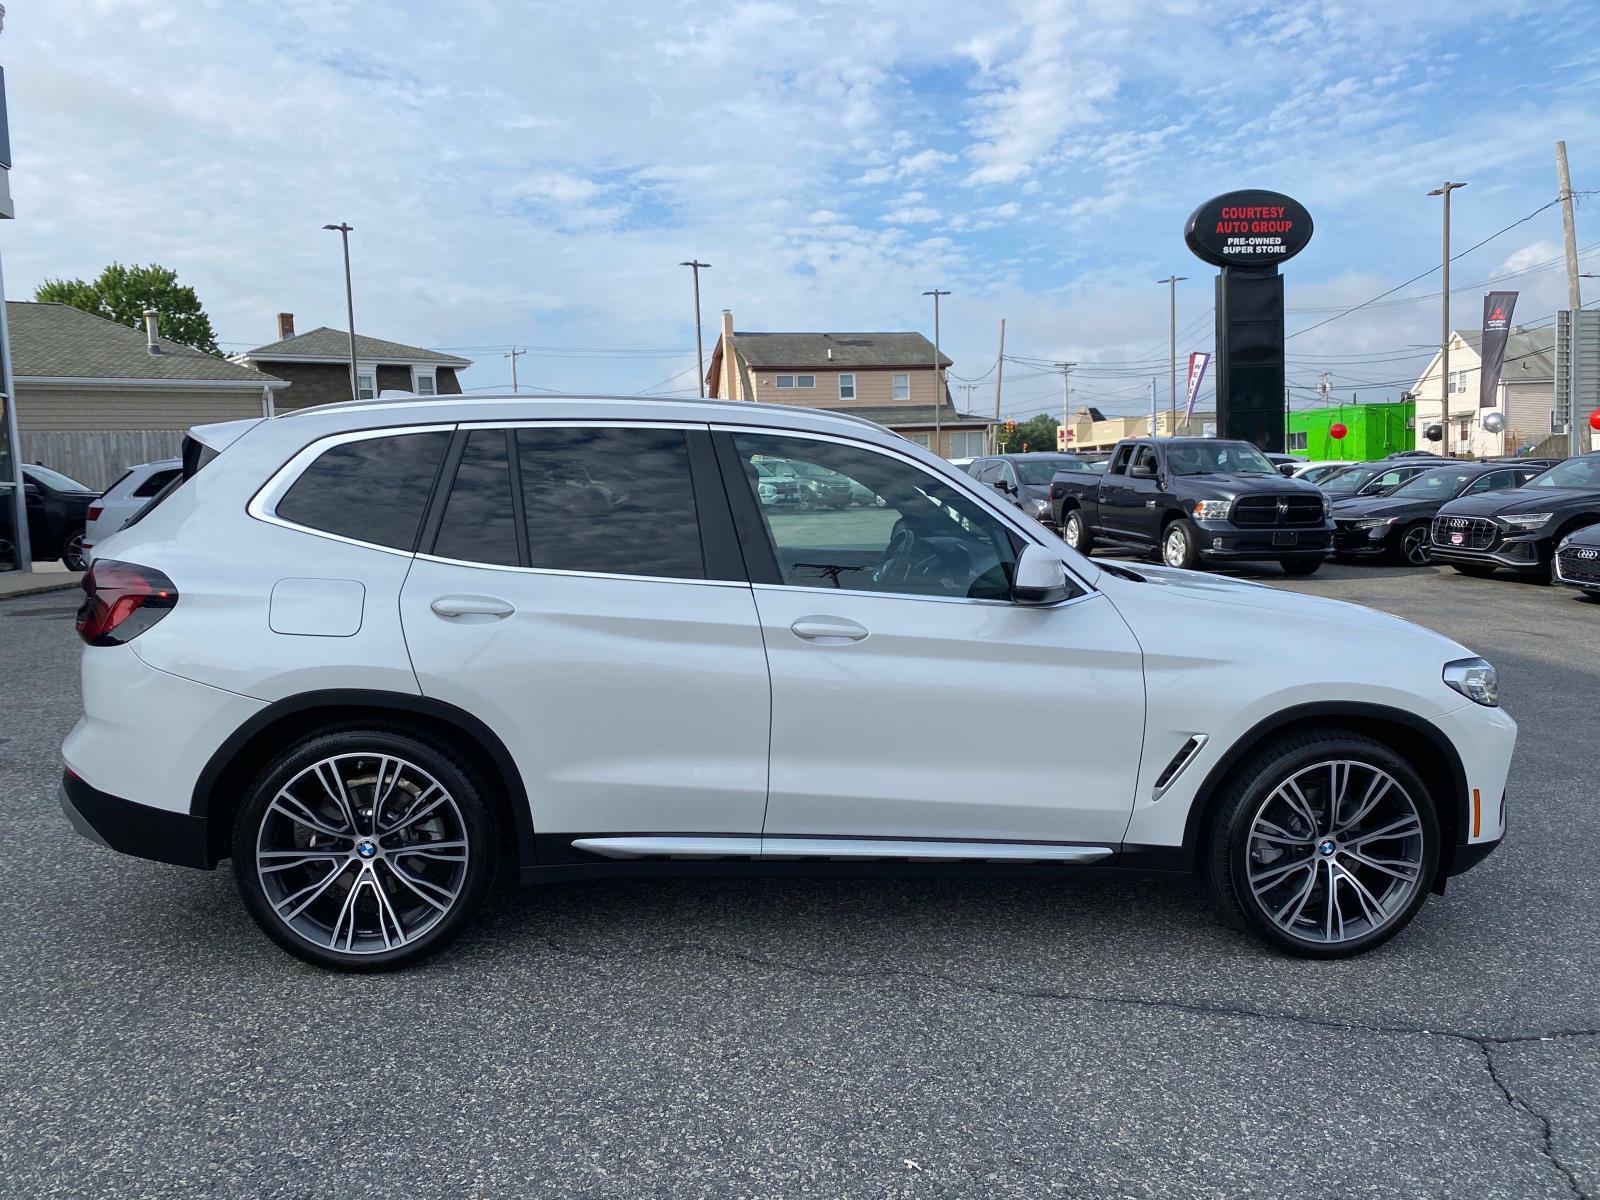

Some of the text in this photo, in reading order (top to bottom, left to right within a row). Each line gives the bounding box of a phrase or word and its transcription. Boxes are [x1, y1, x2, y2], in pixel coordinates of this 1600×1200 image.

[1222, 207, 1285, 218] COURTESY
[1216, 221, 1293, 233] AUTO GROUP
[1228, 237, 1282, 245] PRE-OWNED
[1255, 245, 1287, 253] STORE
